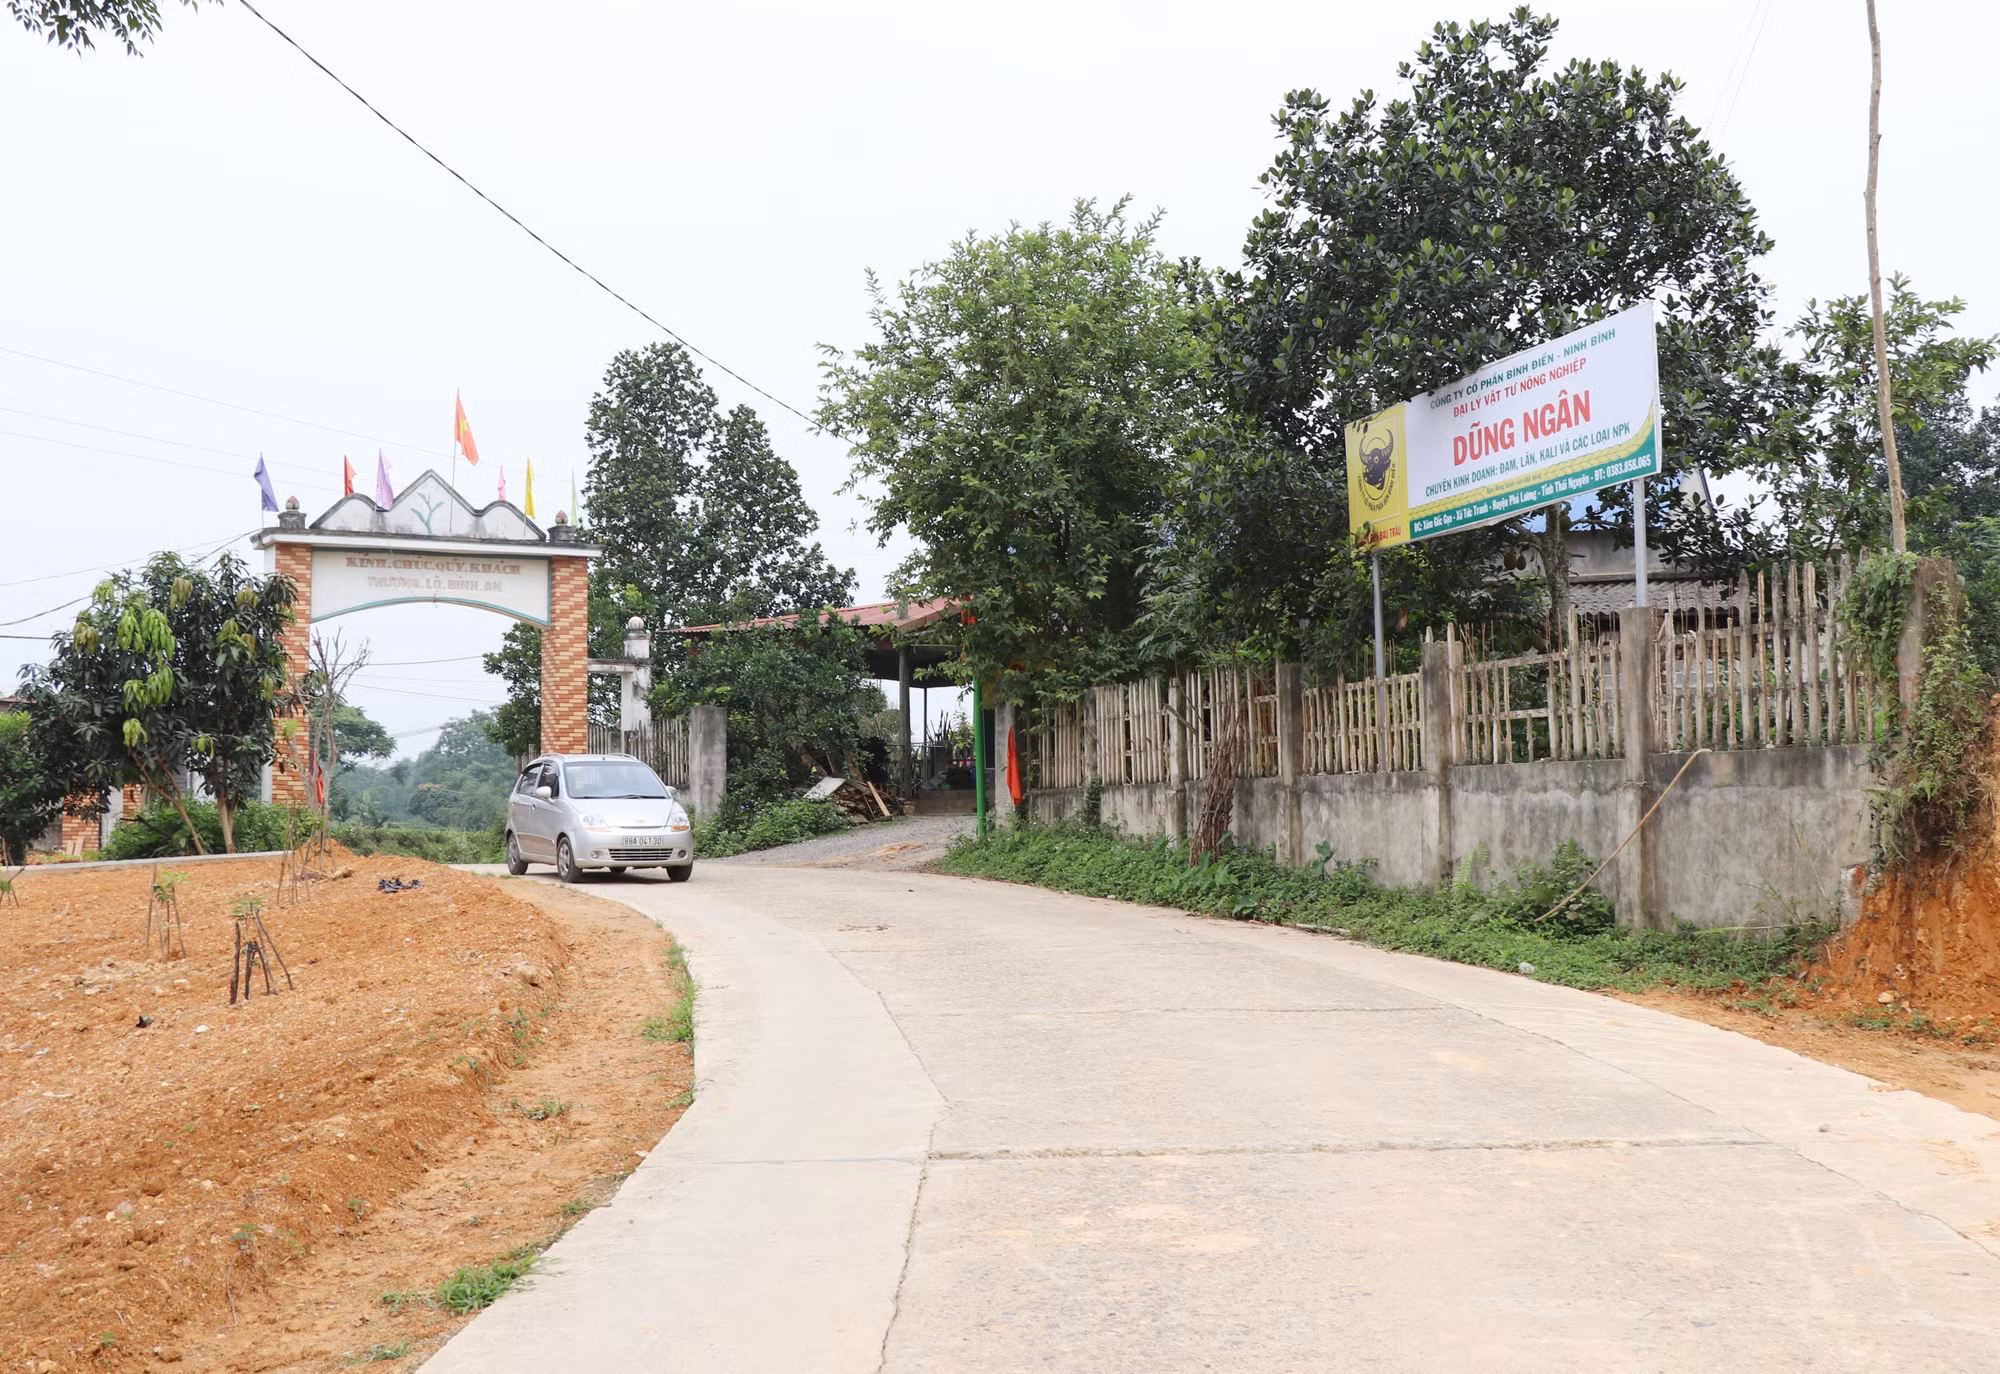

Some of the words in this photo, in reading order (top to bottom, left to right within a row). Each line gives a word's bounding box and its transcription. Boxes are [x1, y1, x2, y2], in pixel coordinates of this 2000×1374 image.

[1430, 394, 1451, 409] CÔNG
[1453, 389, 1463, 400] TY
[1466, 379, 1478, 395] CỔ
[1506, 363, 1528, 379] BÌNH
[1564, 340, 1587, 357] NINH
[1590, 328, 1615, 346] BÌNH
[1453, 403, 1468, 417] ĐẠI
[1470, 395, 1481, 411] LÝ
[1484, 390, 1501, 406] VẬT
[1504, 382, 1518, 398] TƯ
[1520, 373, 1546, 392] NÔNG
[1549, 357, 1586, 381] NGHIỆP
[1426, 478, 1452, 497] CHUYÊN
[1453, 474, 1470, 489] KINH
[1471, 465, 1498, 483] DOANH:
[1499, 459, 1518, 475] ĐẠM,
[1520, 450, 1538, 469] LÂN,
[1540, 442, 1558, 461] KALI
[1559, 438, 1570, 455] VÀ
[1572, 433, 1589, 451] CÁC
[1591, 428, 1610, 445] LOẠI
[1612, 422, 1630, 438] NPK
[1453, 418, 1515, 466] DŨNG
[1523, 389, 1591, 443] NGÂN
[1473, 502, 1488, 516] Tranh
[1554, 478, 1568, 492] Thái
[1568, 474, 1590, 489] Nguyên
